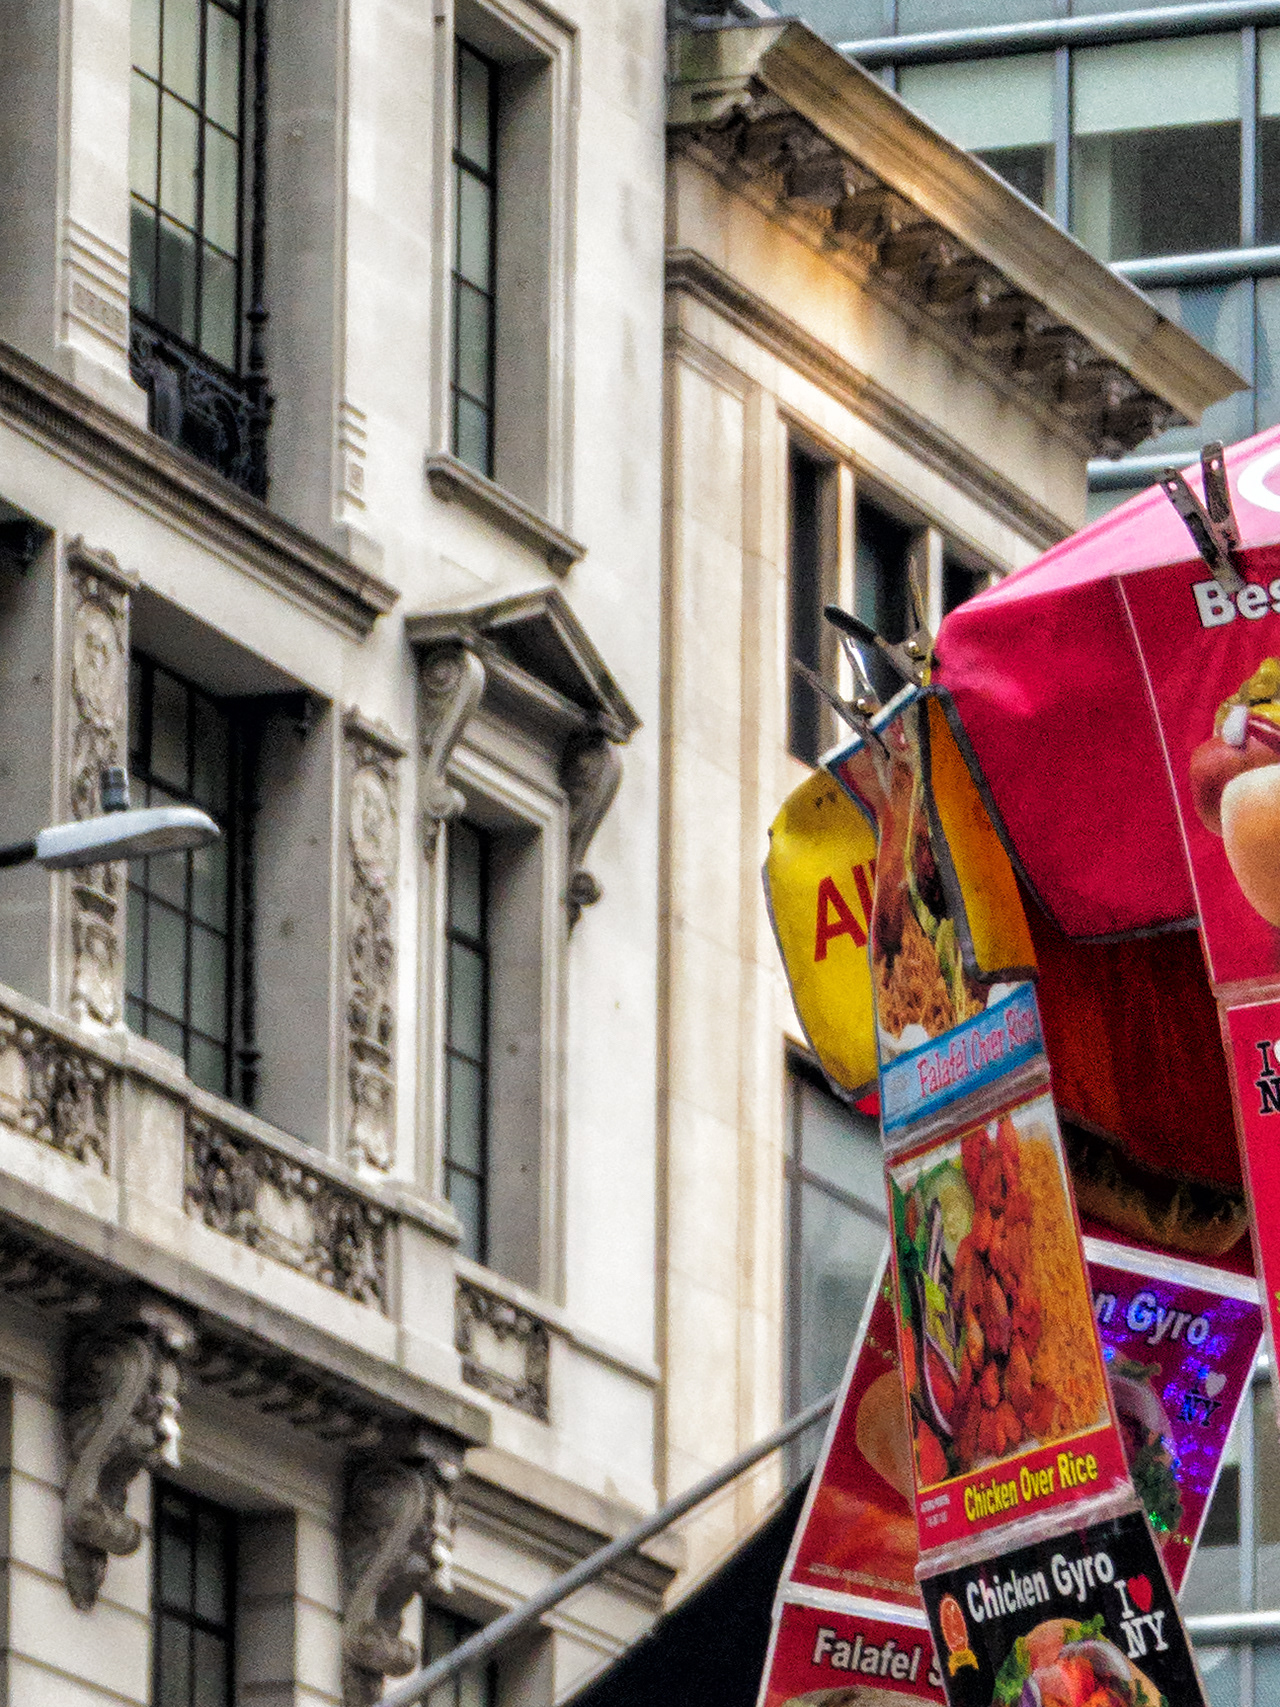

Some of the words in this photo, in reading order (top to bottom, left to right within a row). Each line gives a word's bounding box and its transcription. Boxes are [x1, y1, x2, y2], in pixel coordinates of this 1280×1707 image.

[1256, 1041, 1275, 1077] I
[1126, 1291, 1210, 1348] Gyro
[964, 1475, 1019, 1521] Chicken
[1021, 1464, 1055, 1506] Over
[1058, 1451, 1098, 1491] Rice
[966, 1560, 1050, 1624] Chicken
[1052, 1550, 1114, 1601] Gyro
[1114, 1579, 1133, 1620] I
[812, 1629, 919, 1683] Falafel
[1121, 1611, 1169, 1659] NY
